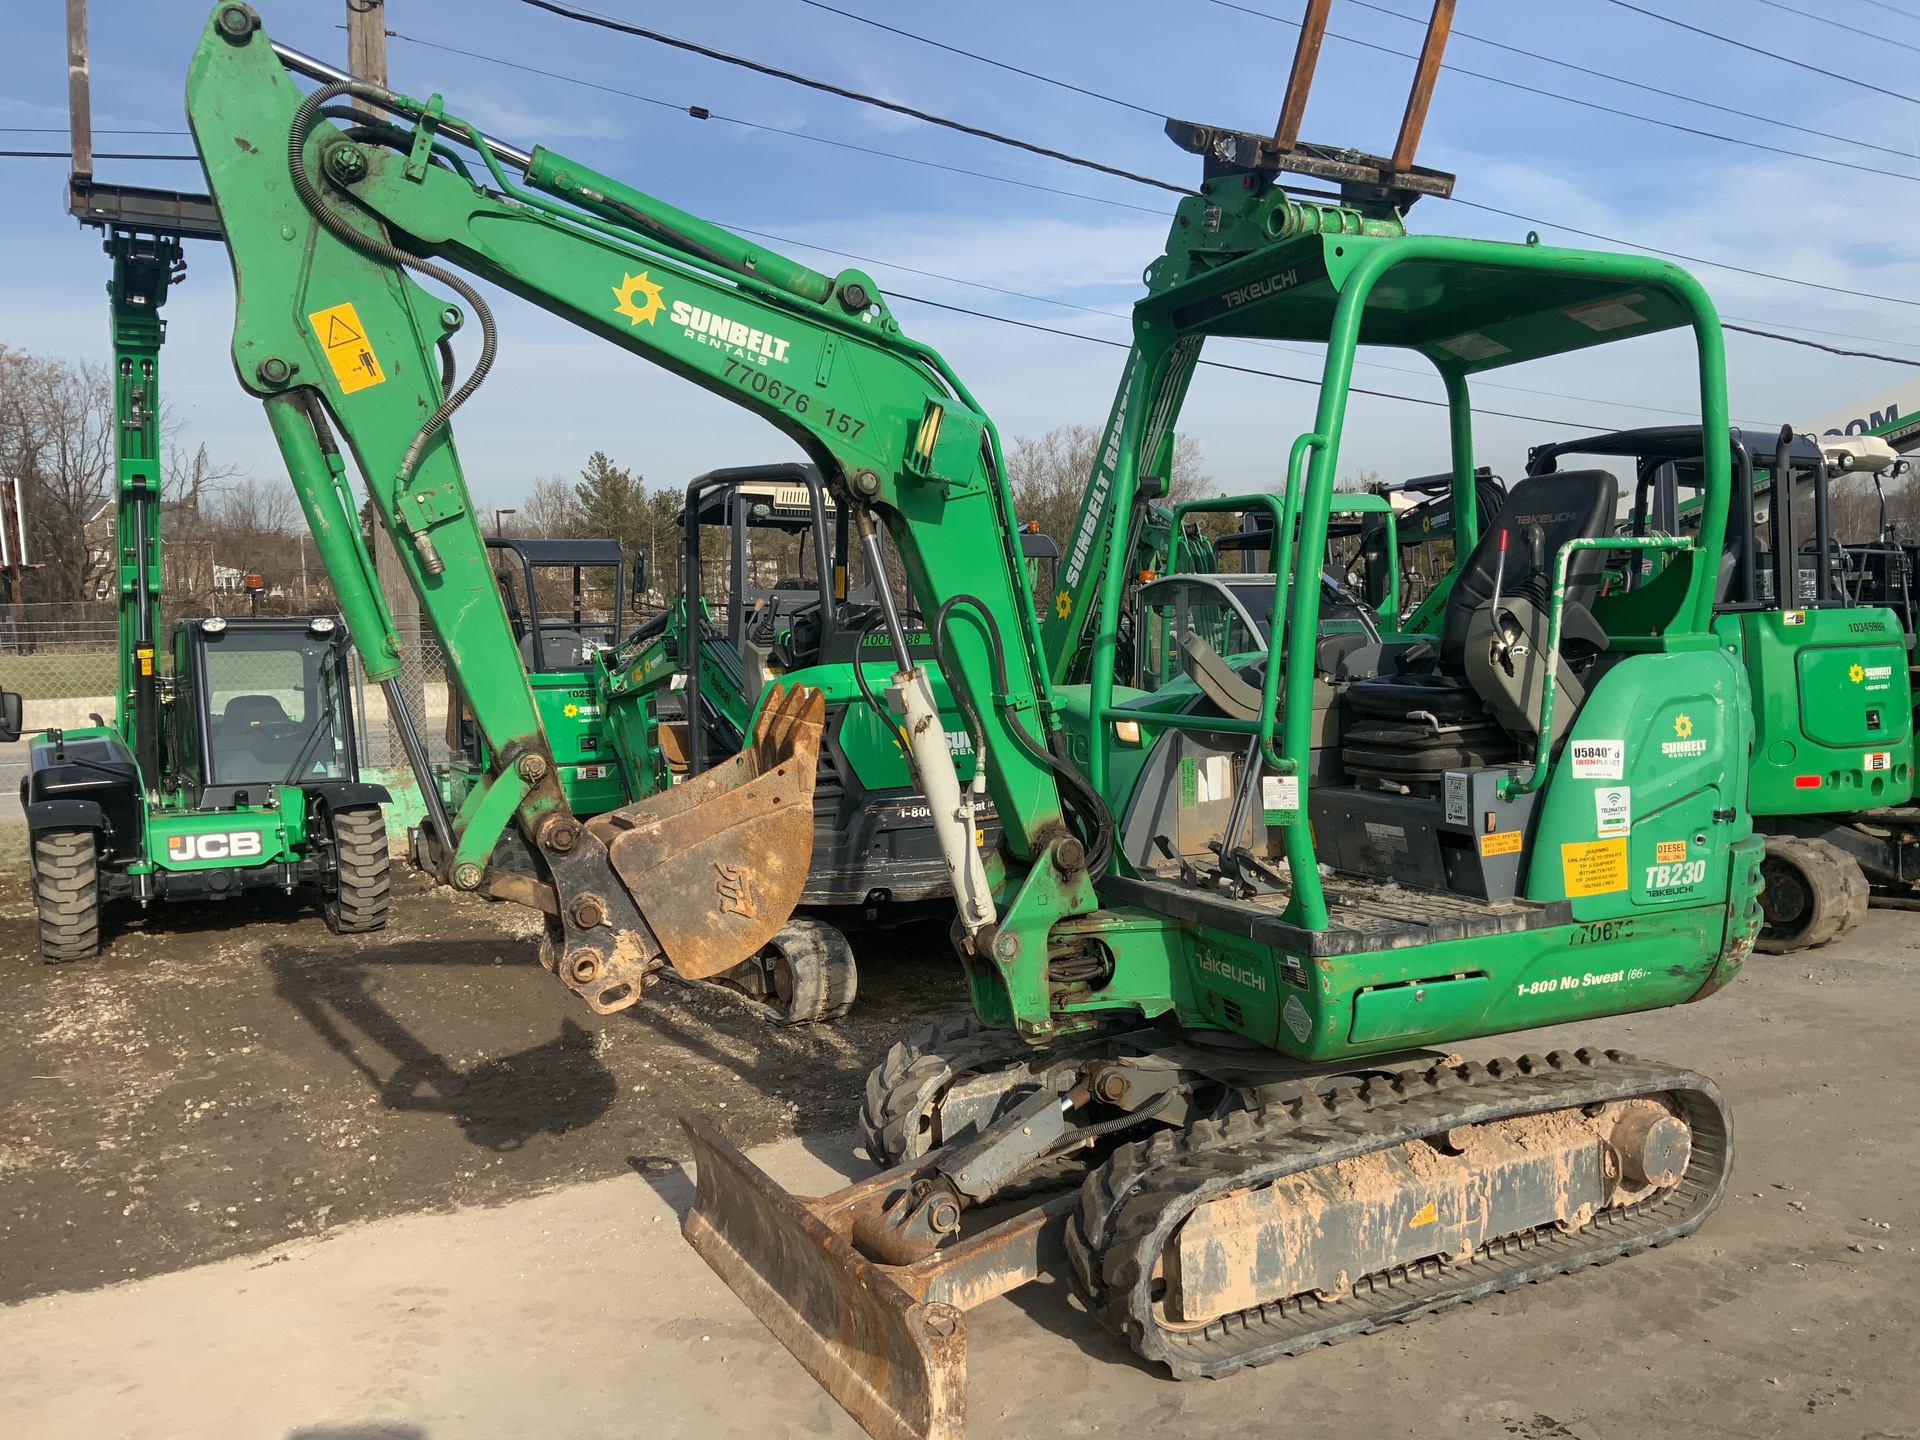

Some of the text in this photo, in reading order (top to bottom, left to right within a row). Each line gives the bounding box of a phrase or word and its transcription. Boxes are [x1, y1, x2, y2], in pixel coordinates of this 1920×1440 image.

[669, 299, 790, 363] SUNBELT
[683, 328, 768, 367] RENTALS
[724, 356, 866, 440] 770676 157
[1066, 469, 1111, 589] SUNBELT
[710, 671, 732, 707] Bobcat
[1661, 739, 1707, 754] SUNBELT
[1601, 806, 1627, 814] TELEMATICS
[169, 831, 261, 861] JCB
[1657, 844, 1686, 854] DIESEL
[1645, 859, 1706, 889] TB230
[1646, 885, 1694, 898] TAKEUCHI
[1517, 979, 1558, 997] 1-800
[1560, 975, 1580, 990] No
[1581, 969, 1625, 987] Sweat
